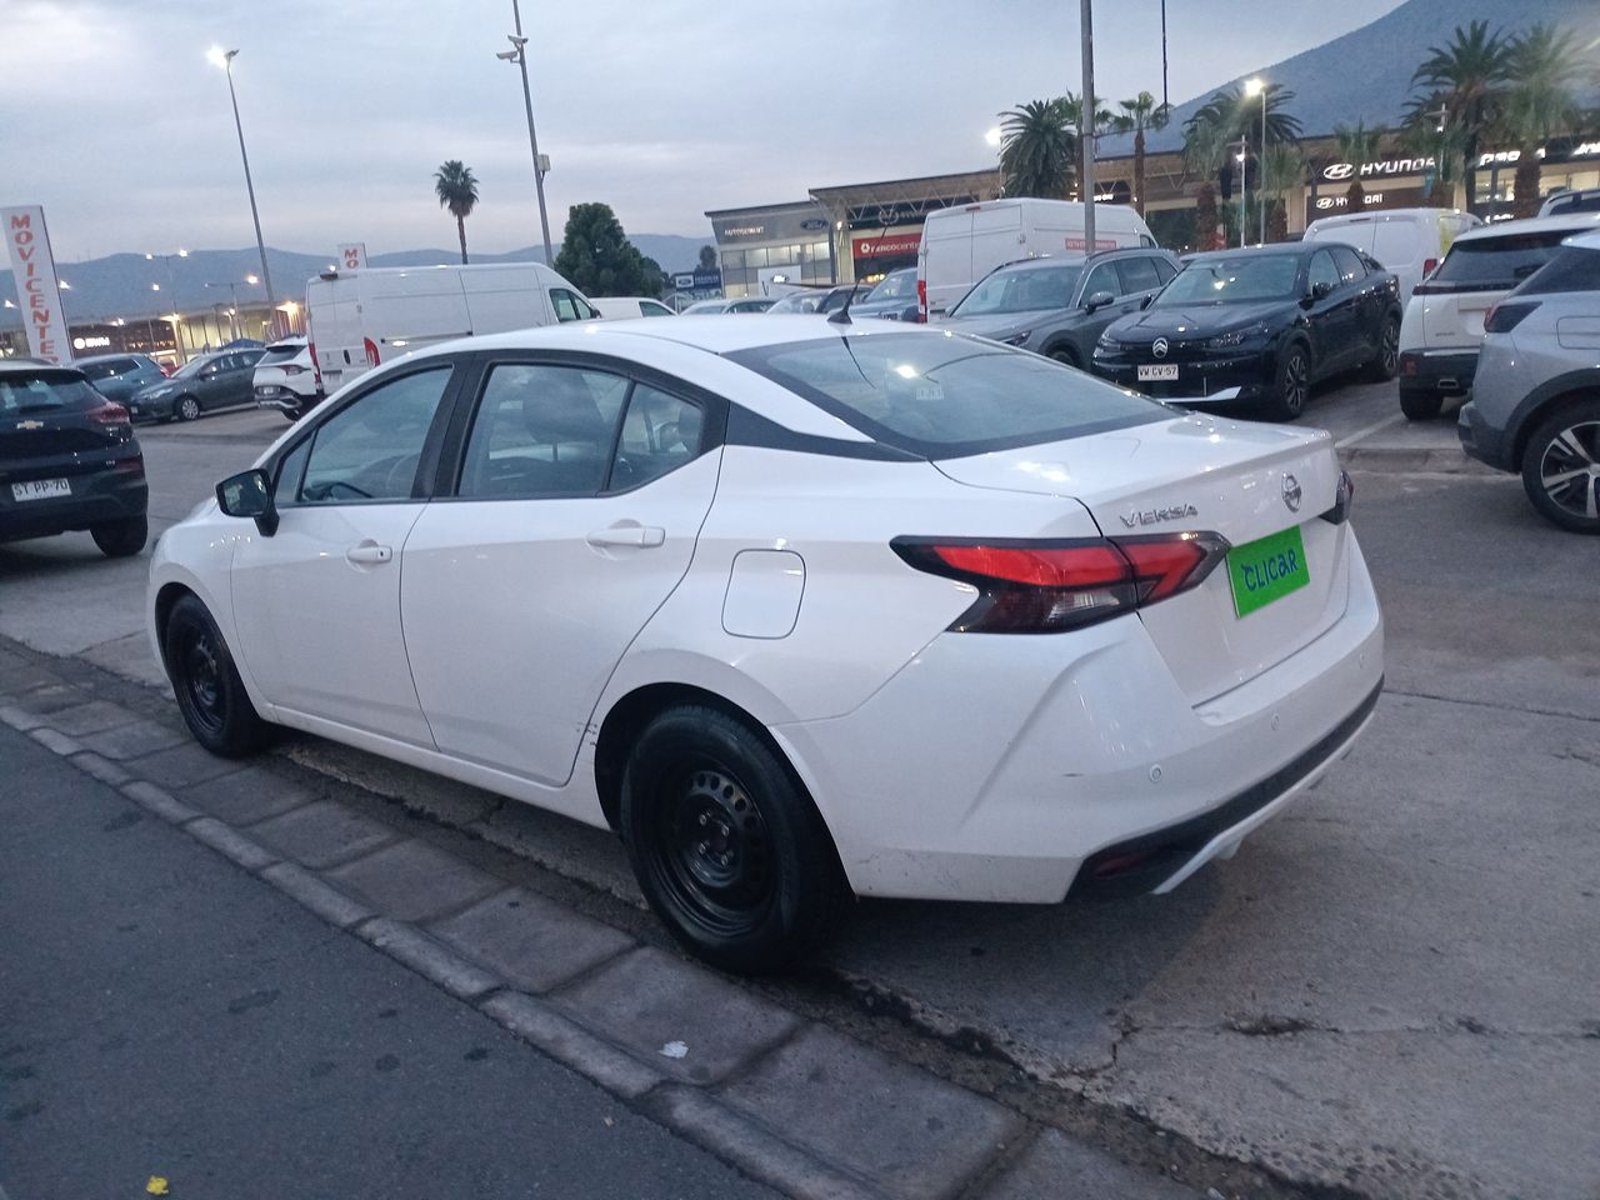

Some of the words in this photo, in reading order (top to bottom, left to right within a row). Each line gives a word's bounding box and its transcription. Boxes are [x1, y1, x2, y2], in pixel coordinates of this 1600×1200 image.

[1359, 157, 1436, 175] HYUNDA
[1335, 193, 1384, 207] HYDAI
[1119, 503, 1199, 528] VERSA
